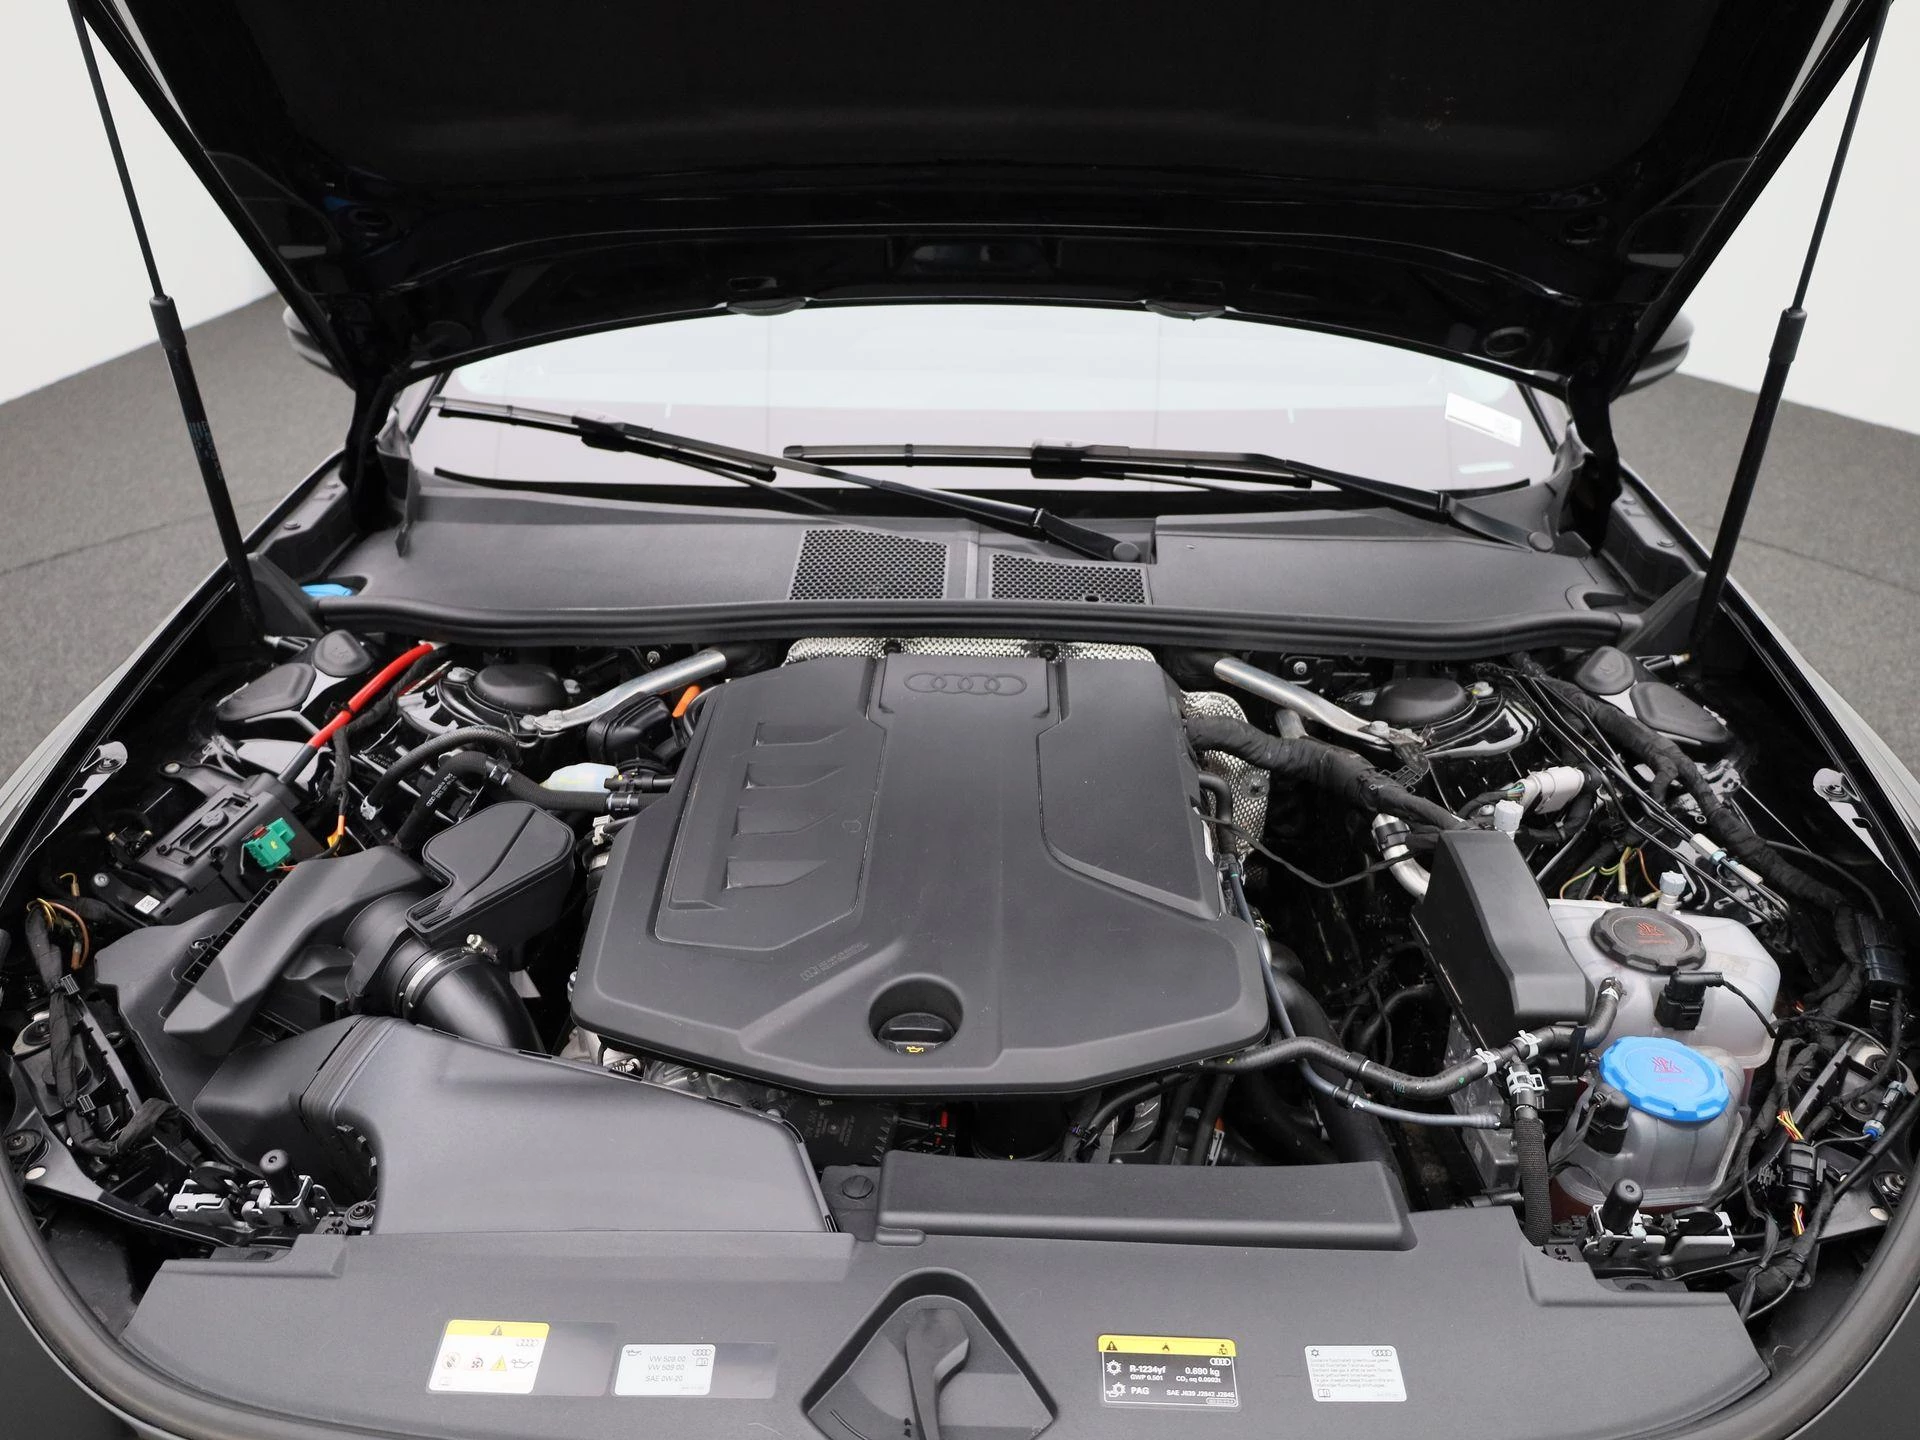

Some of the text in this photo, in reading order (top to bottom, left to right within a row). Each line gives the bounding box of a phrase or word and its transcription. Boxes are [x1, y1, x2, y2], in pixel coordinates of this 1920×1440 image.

[1129, 1365, 1166, 1375] R-1234yf
[1209, 1368, 1220, 1377] kg
[1130, 1386, 1150, 1394] PAG
